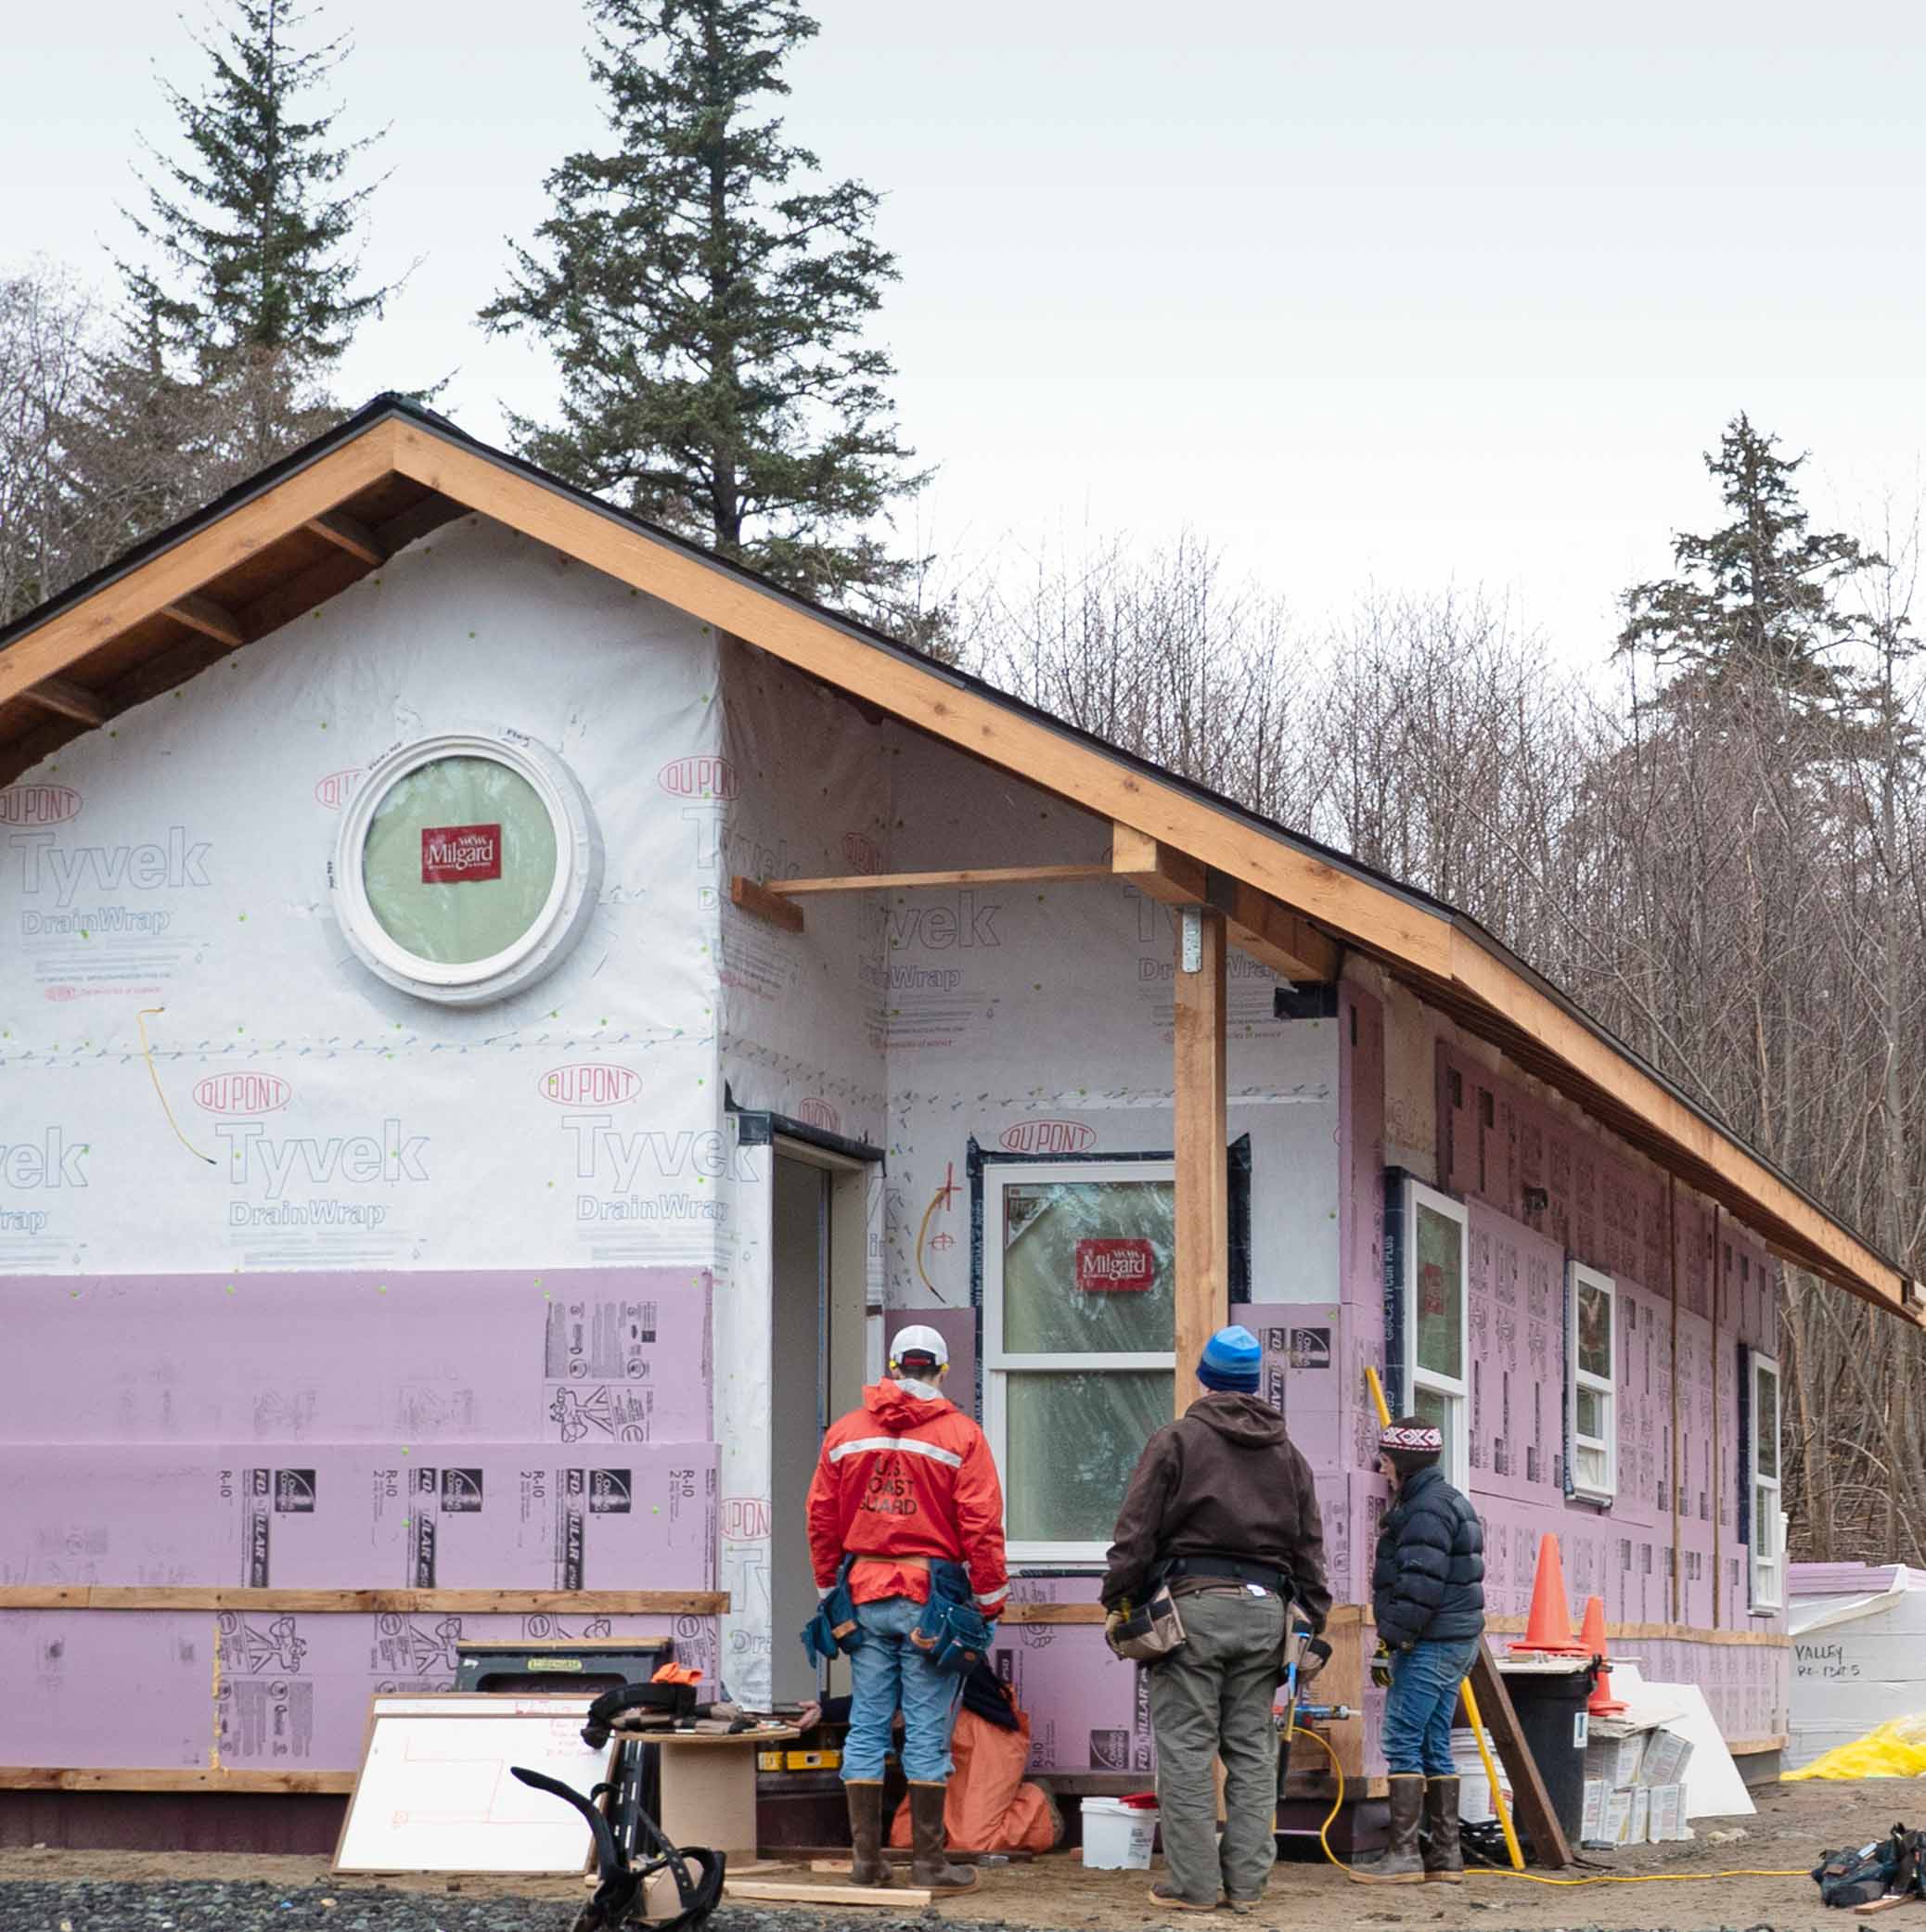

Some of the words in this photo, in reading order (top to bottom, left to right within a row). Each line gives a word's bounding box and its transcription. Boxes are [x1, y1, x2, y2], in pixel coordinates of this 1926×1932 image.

[8, 825, 213, 908] Tyvek
[428, 840, 494, 870] Milgard
[201, 1075, 283, 1111] DUPONT
[548, 1067, 635, 1103] DUPONT
[1008, 1123, 1090, 1152] DUPONT
[215, 1119, 430, 1200] Tyvek
[229, 1199, 386, 1231] DrainWrap
[1082, 1253, 1146, 1281] Milgard
[220, 1469, 232, 1498] R-10
[385, 1469, 398, 1497] R-10
[520, 1470, 532, 1479] 2
[533, 1469, 546, 1498] R-10
[669, 1470, 681, 1478] 2
[682, 1469, 695, 1498] R-10
[868, 1476, 914, 1496] OAST
